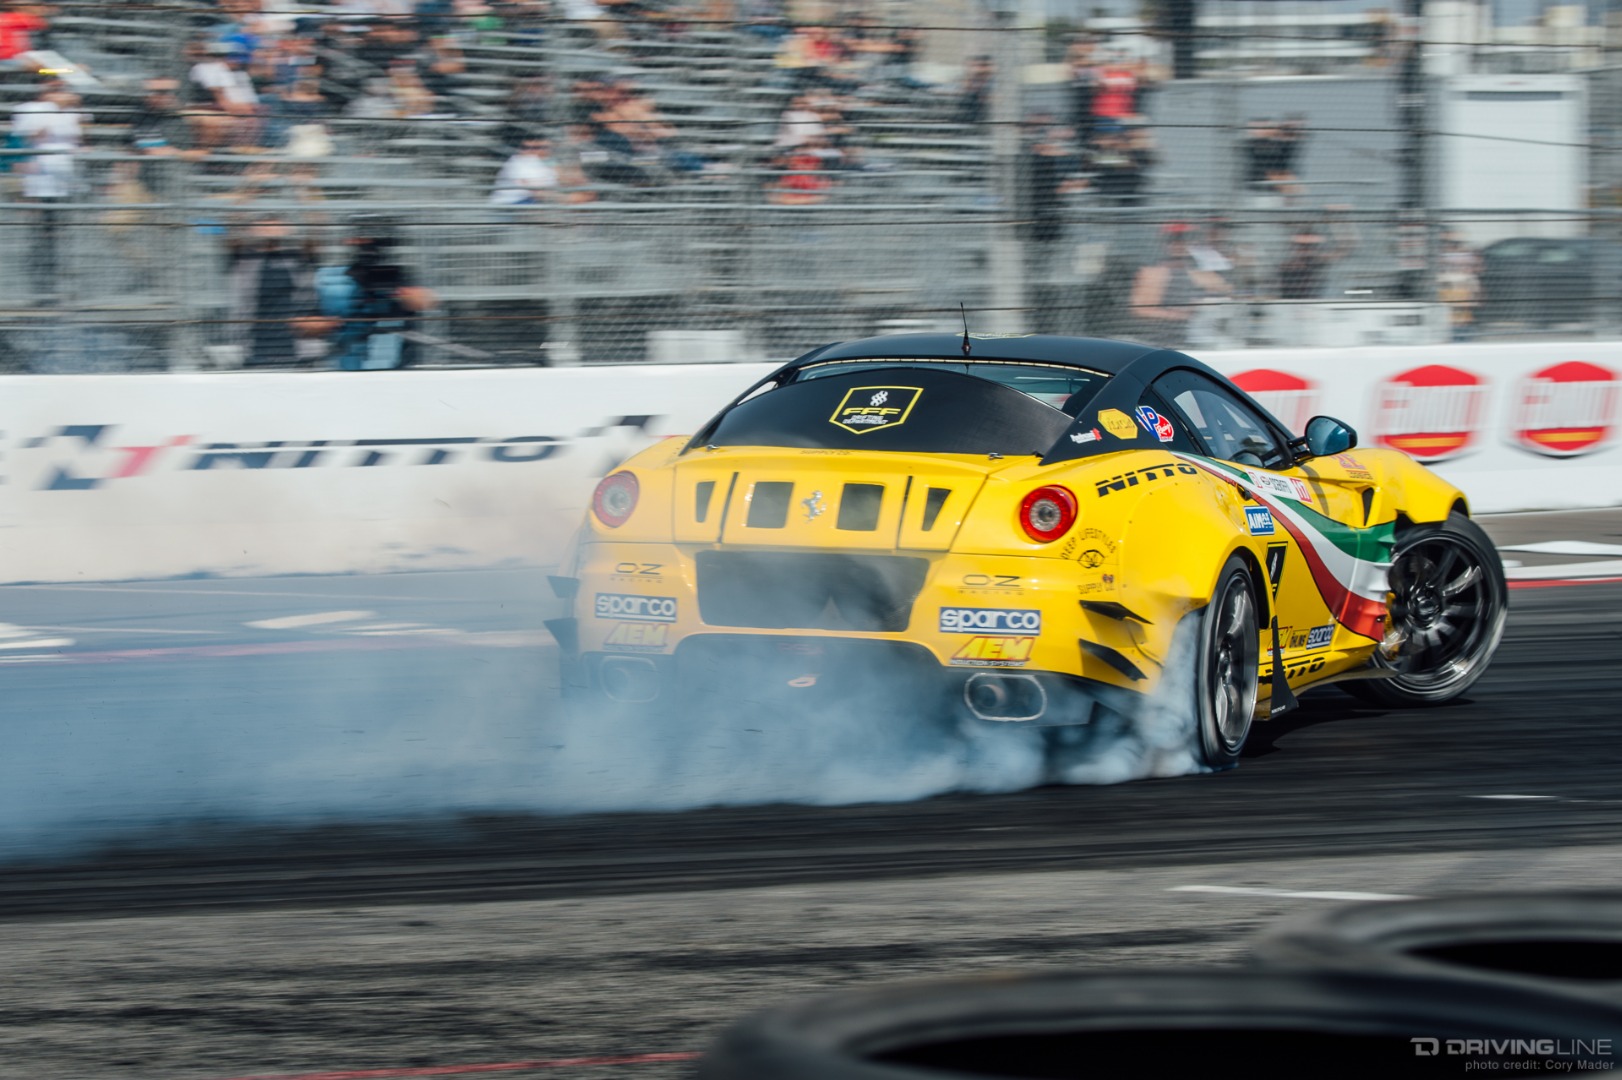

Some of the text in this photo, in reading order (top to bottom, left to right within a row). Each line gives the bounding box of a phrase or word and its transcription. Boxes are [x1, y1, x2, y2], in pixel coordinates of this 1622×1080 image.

[842, 407, 901, 415] FFF
[1095, 463, 1197, 497] NITTO
[597, 595, 675, 617] sparco
[941, 609, 1040, 632] sparco
[603, 622, 669, 646] AEM
[951, 636, 1035, 661] AEM
